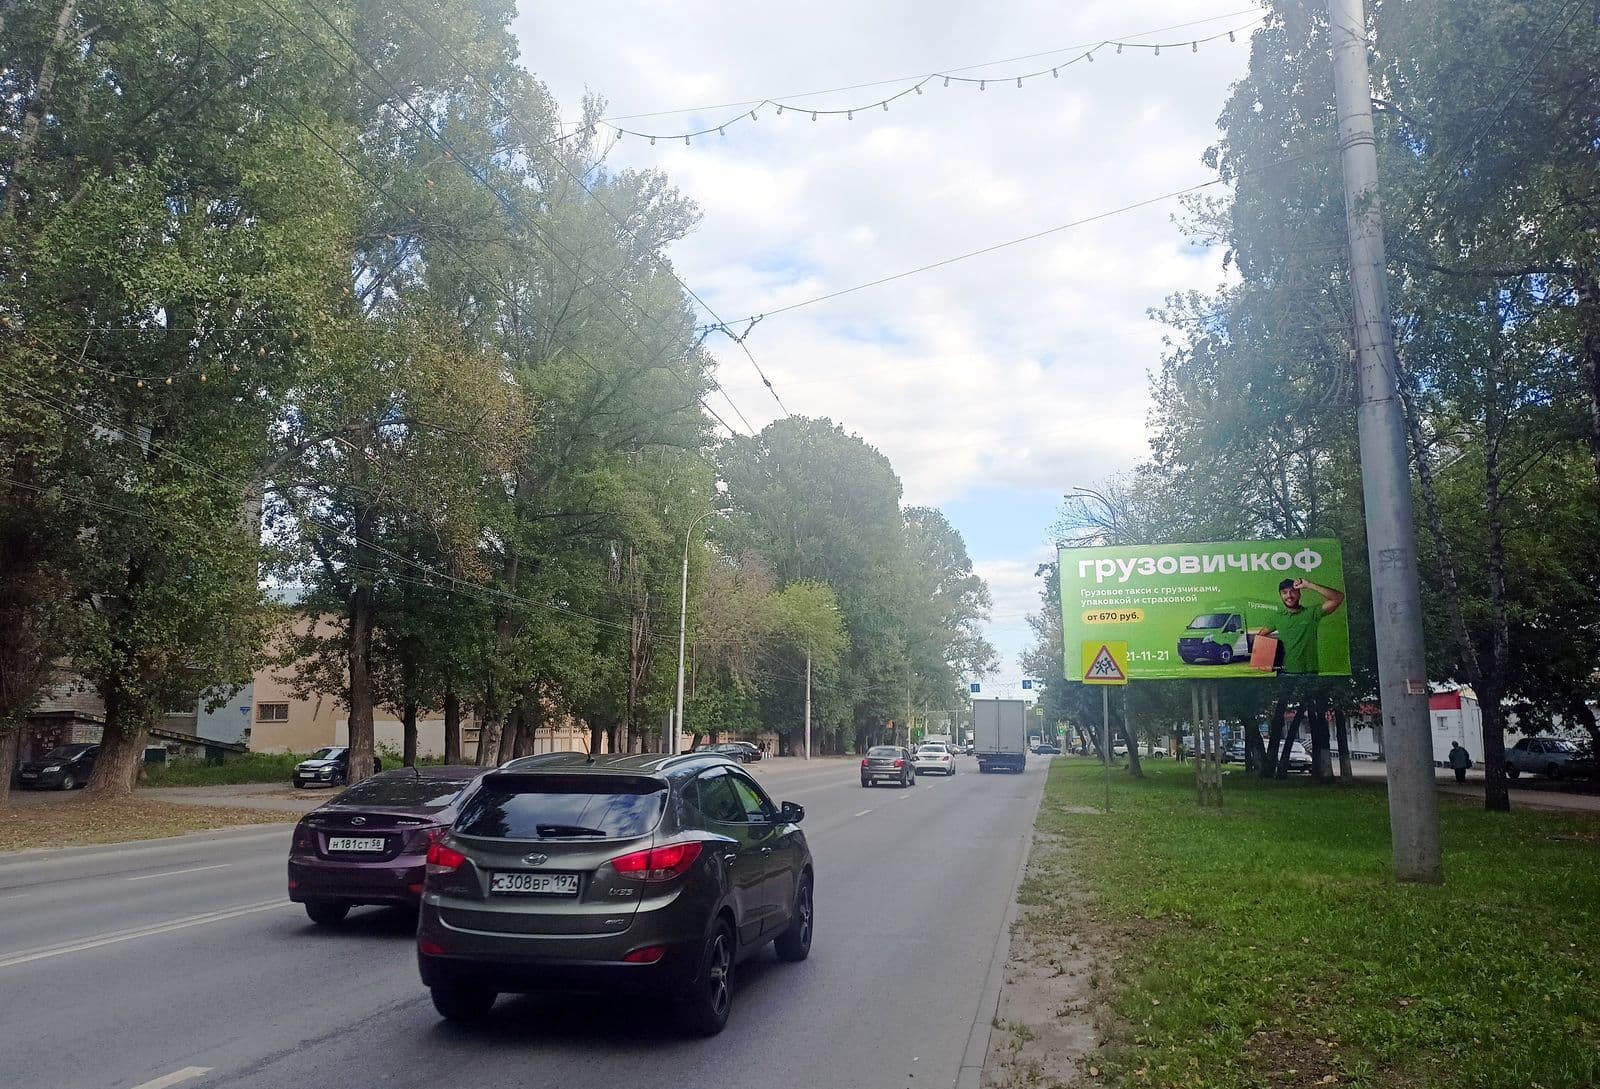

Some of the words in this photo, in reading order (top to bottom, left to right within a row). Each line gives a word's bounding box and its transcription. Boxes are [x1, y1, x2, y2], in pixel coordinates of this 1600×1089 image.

[1081, 588, 1123, 598] Грузовое
[1125, 587, 1152, 595] такси
[1161, 585, 1221, 597] грузчиками,
[1081, 596, 1132, 608] упаковкой
[1142, 594, 1198, 605] страховкой
[1099, 612, 1117, 621] 670
[1119, 611, 1140, 622] руб.
